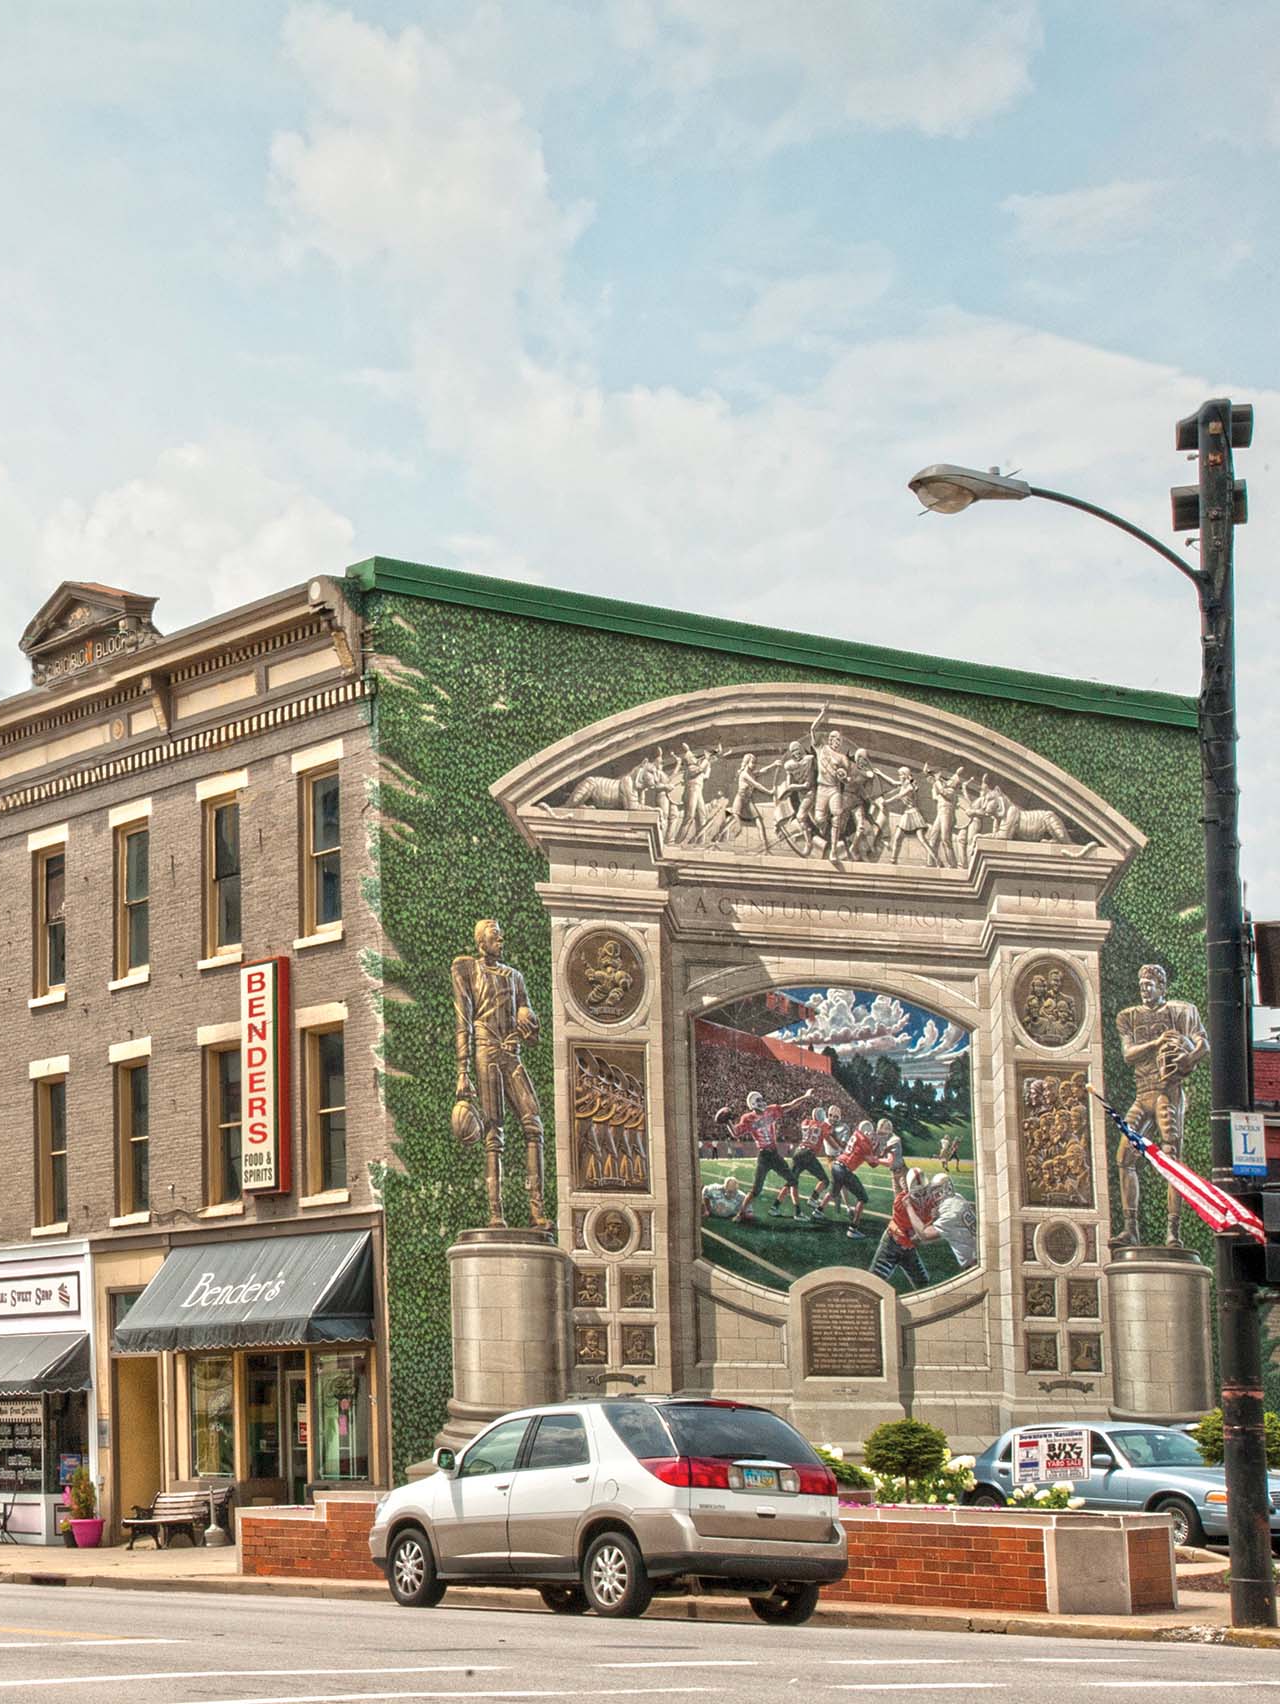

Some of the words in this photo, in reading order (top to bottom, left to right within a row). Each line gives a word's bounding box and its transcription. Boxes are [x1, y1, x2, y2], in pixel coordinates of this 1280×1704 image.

[572, 858, 639, 881] 1894
[1016, 889, 1080, 910] 1994
[694, 895, 709, 914] A
[717, 896, 826, 921] CENTURY
[836, 903, 865, 922] OF
[876, 906, 964, 930] HEROES
[247, 971, 268, 1145] BENDERS
[1241, 1132, 1256, 1155] L
[244, 1152, 264, 1168] FOOD
[266, 1151, 272, 1165] &
[243, 1167, 273, 1184] SPIRITS
[180, 1271, 285, 1308] Bender's
[1046, 1450, 1083, 1460] WAY
[1047, 1442, 1082, 1452] BUY-
